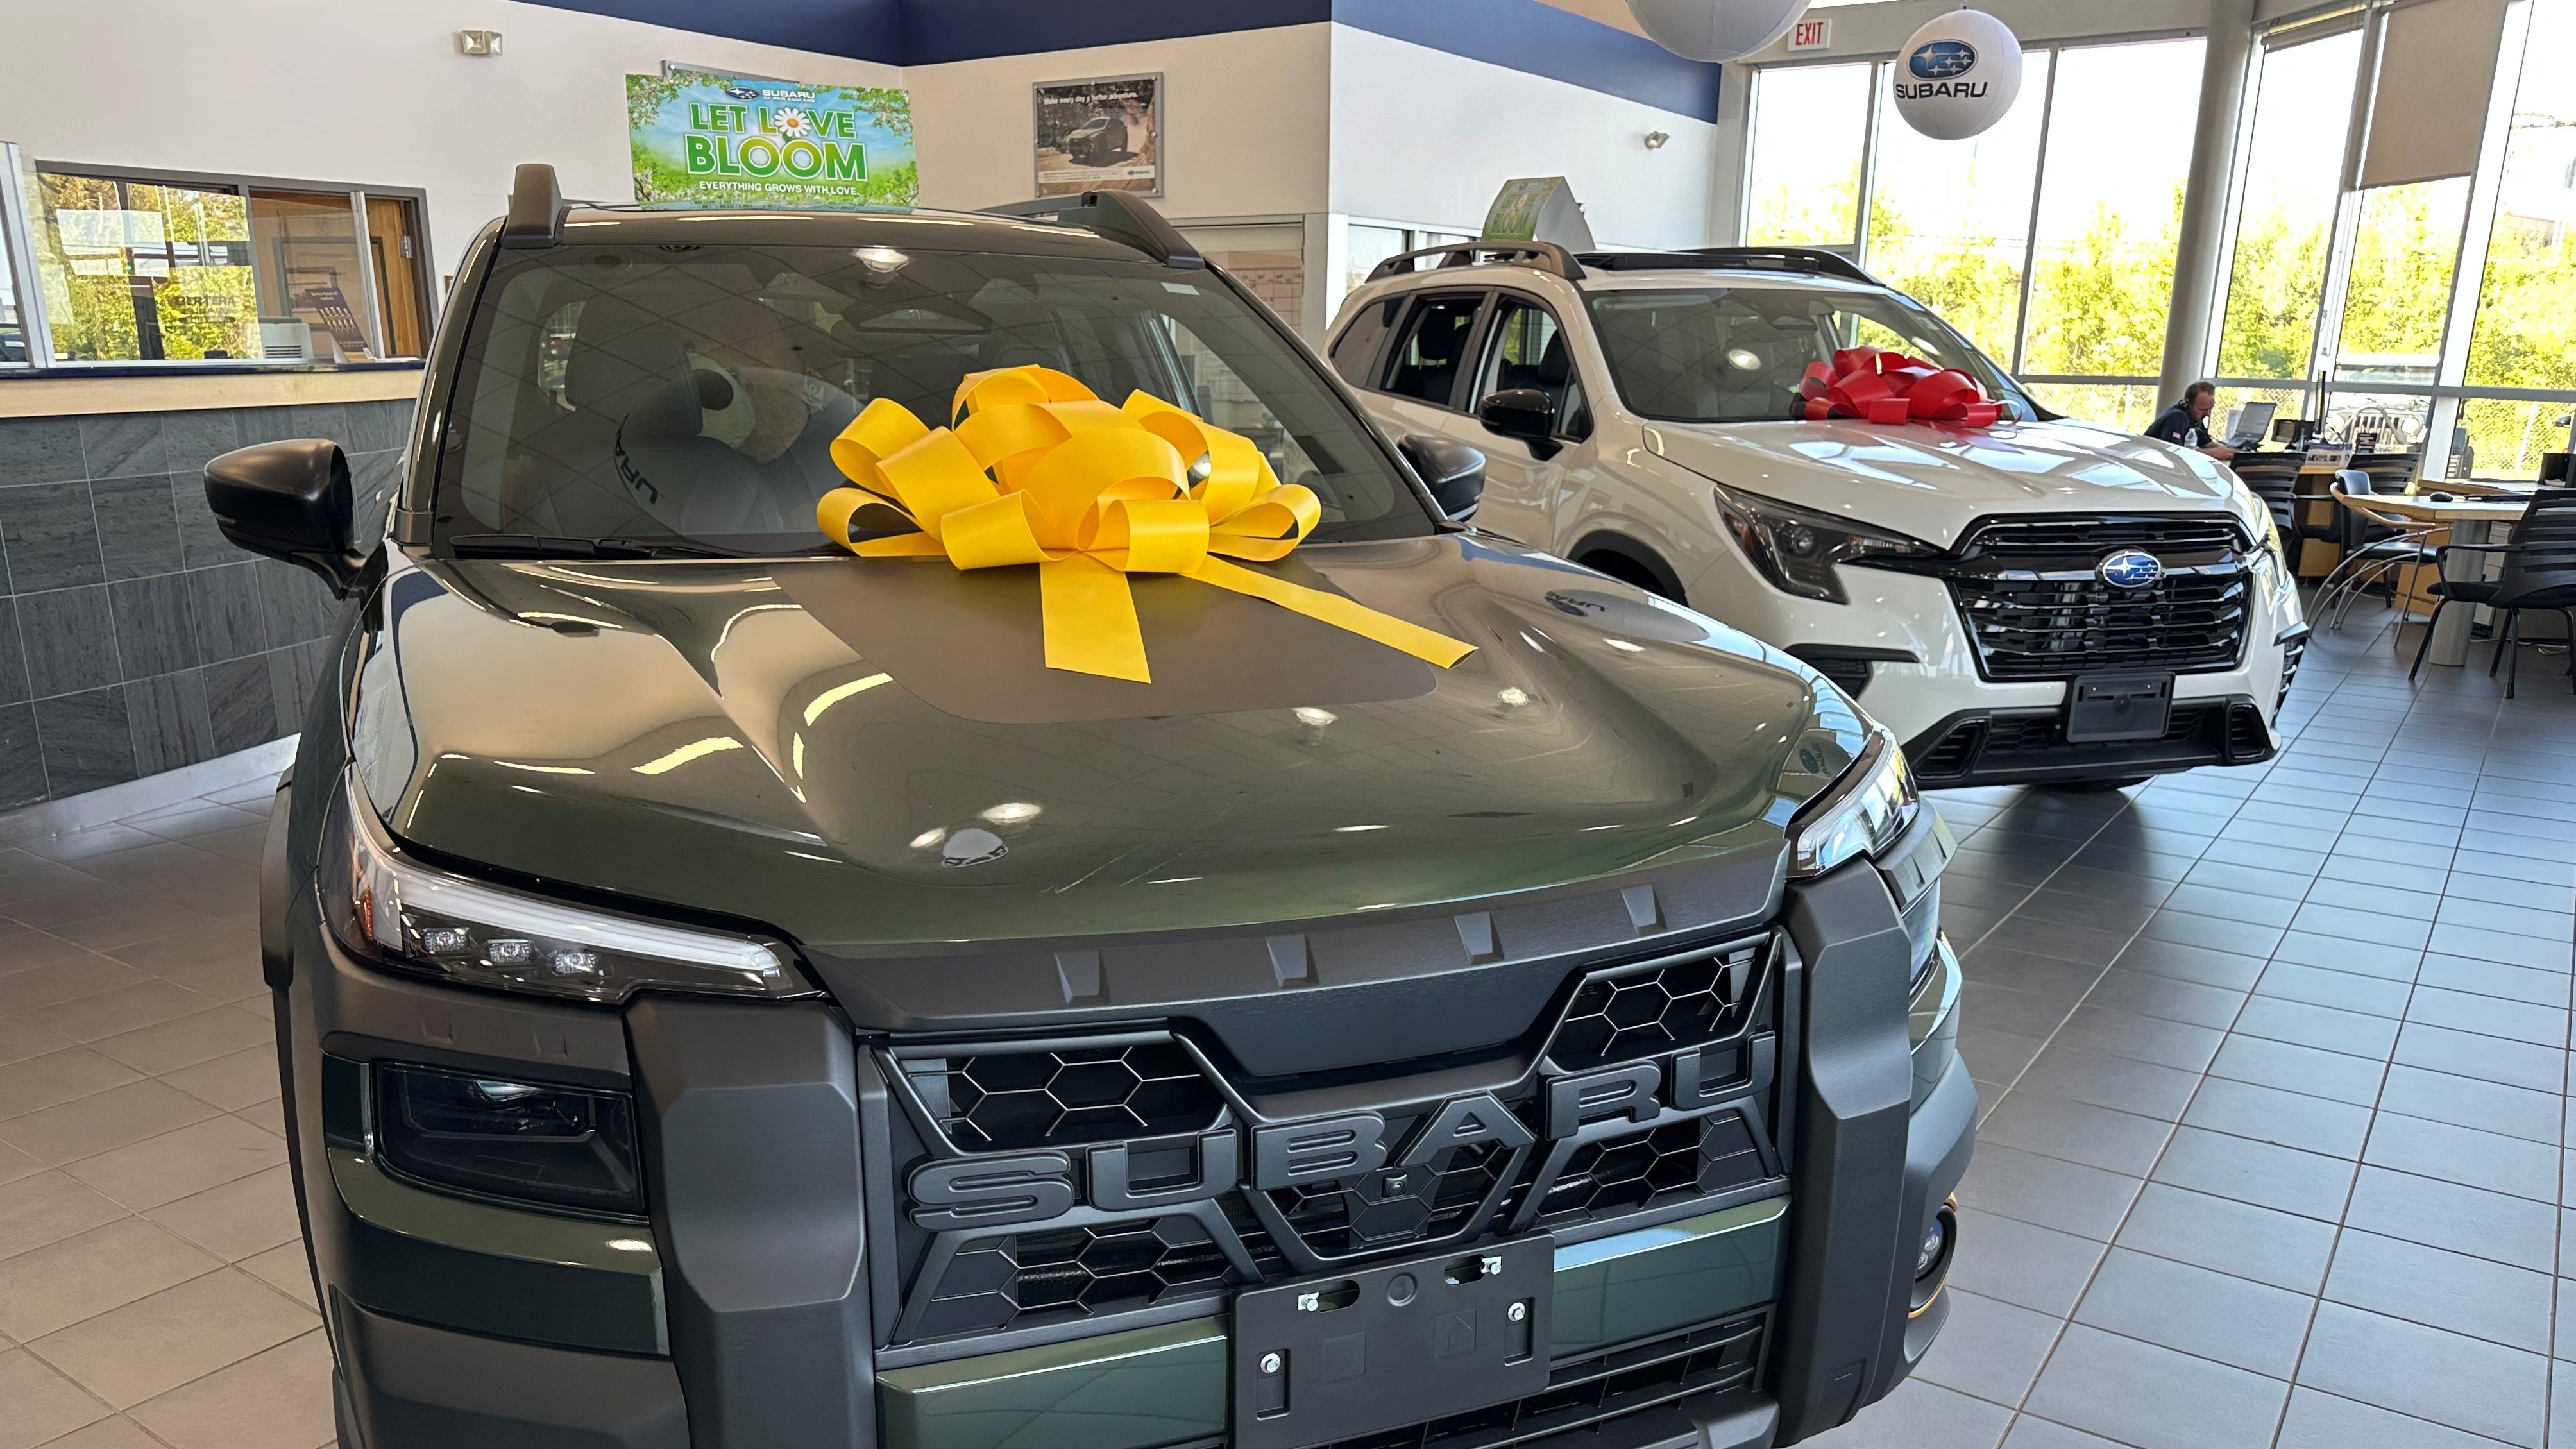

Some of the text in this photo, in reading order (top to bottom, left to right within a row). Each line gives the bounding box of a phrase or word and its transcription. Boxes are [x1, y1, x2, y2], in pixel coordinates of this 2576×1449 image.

[1795, 22, 1824, 46] EXIT
[762, 89, 815, 99] SUBARU
[1895, 82, 1988, 99] SUBARU
[690, 103, 748, 133] LET
[684, 133, 869, 182] BLOOM
[699, 181, 860, 196] EVERYTHING GROWS WITH LOVE.
[908, 1030, 1776, 1231] SUBARU
